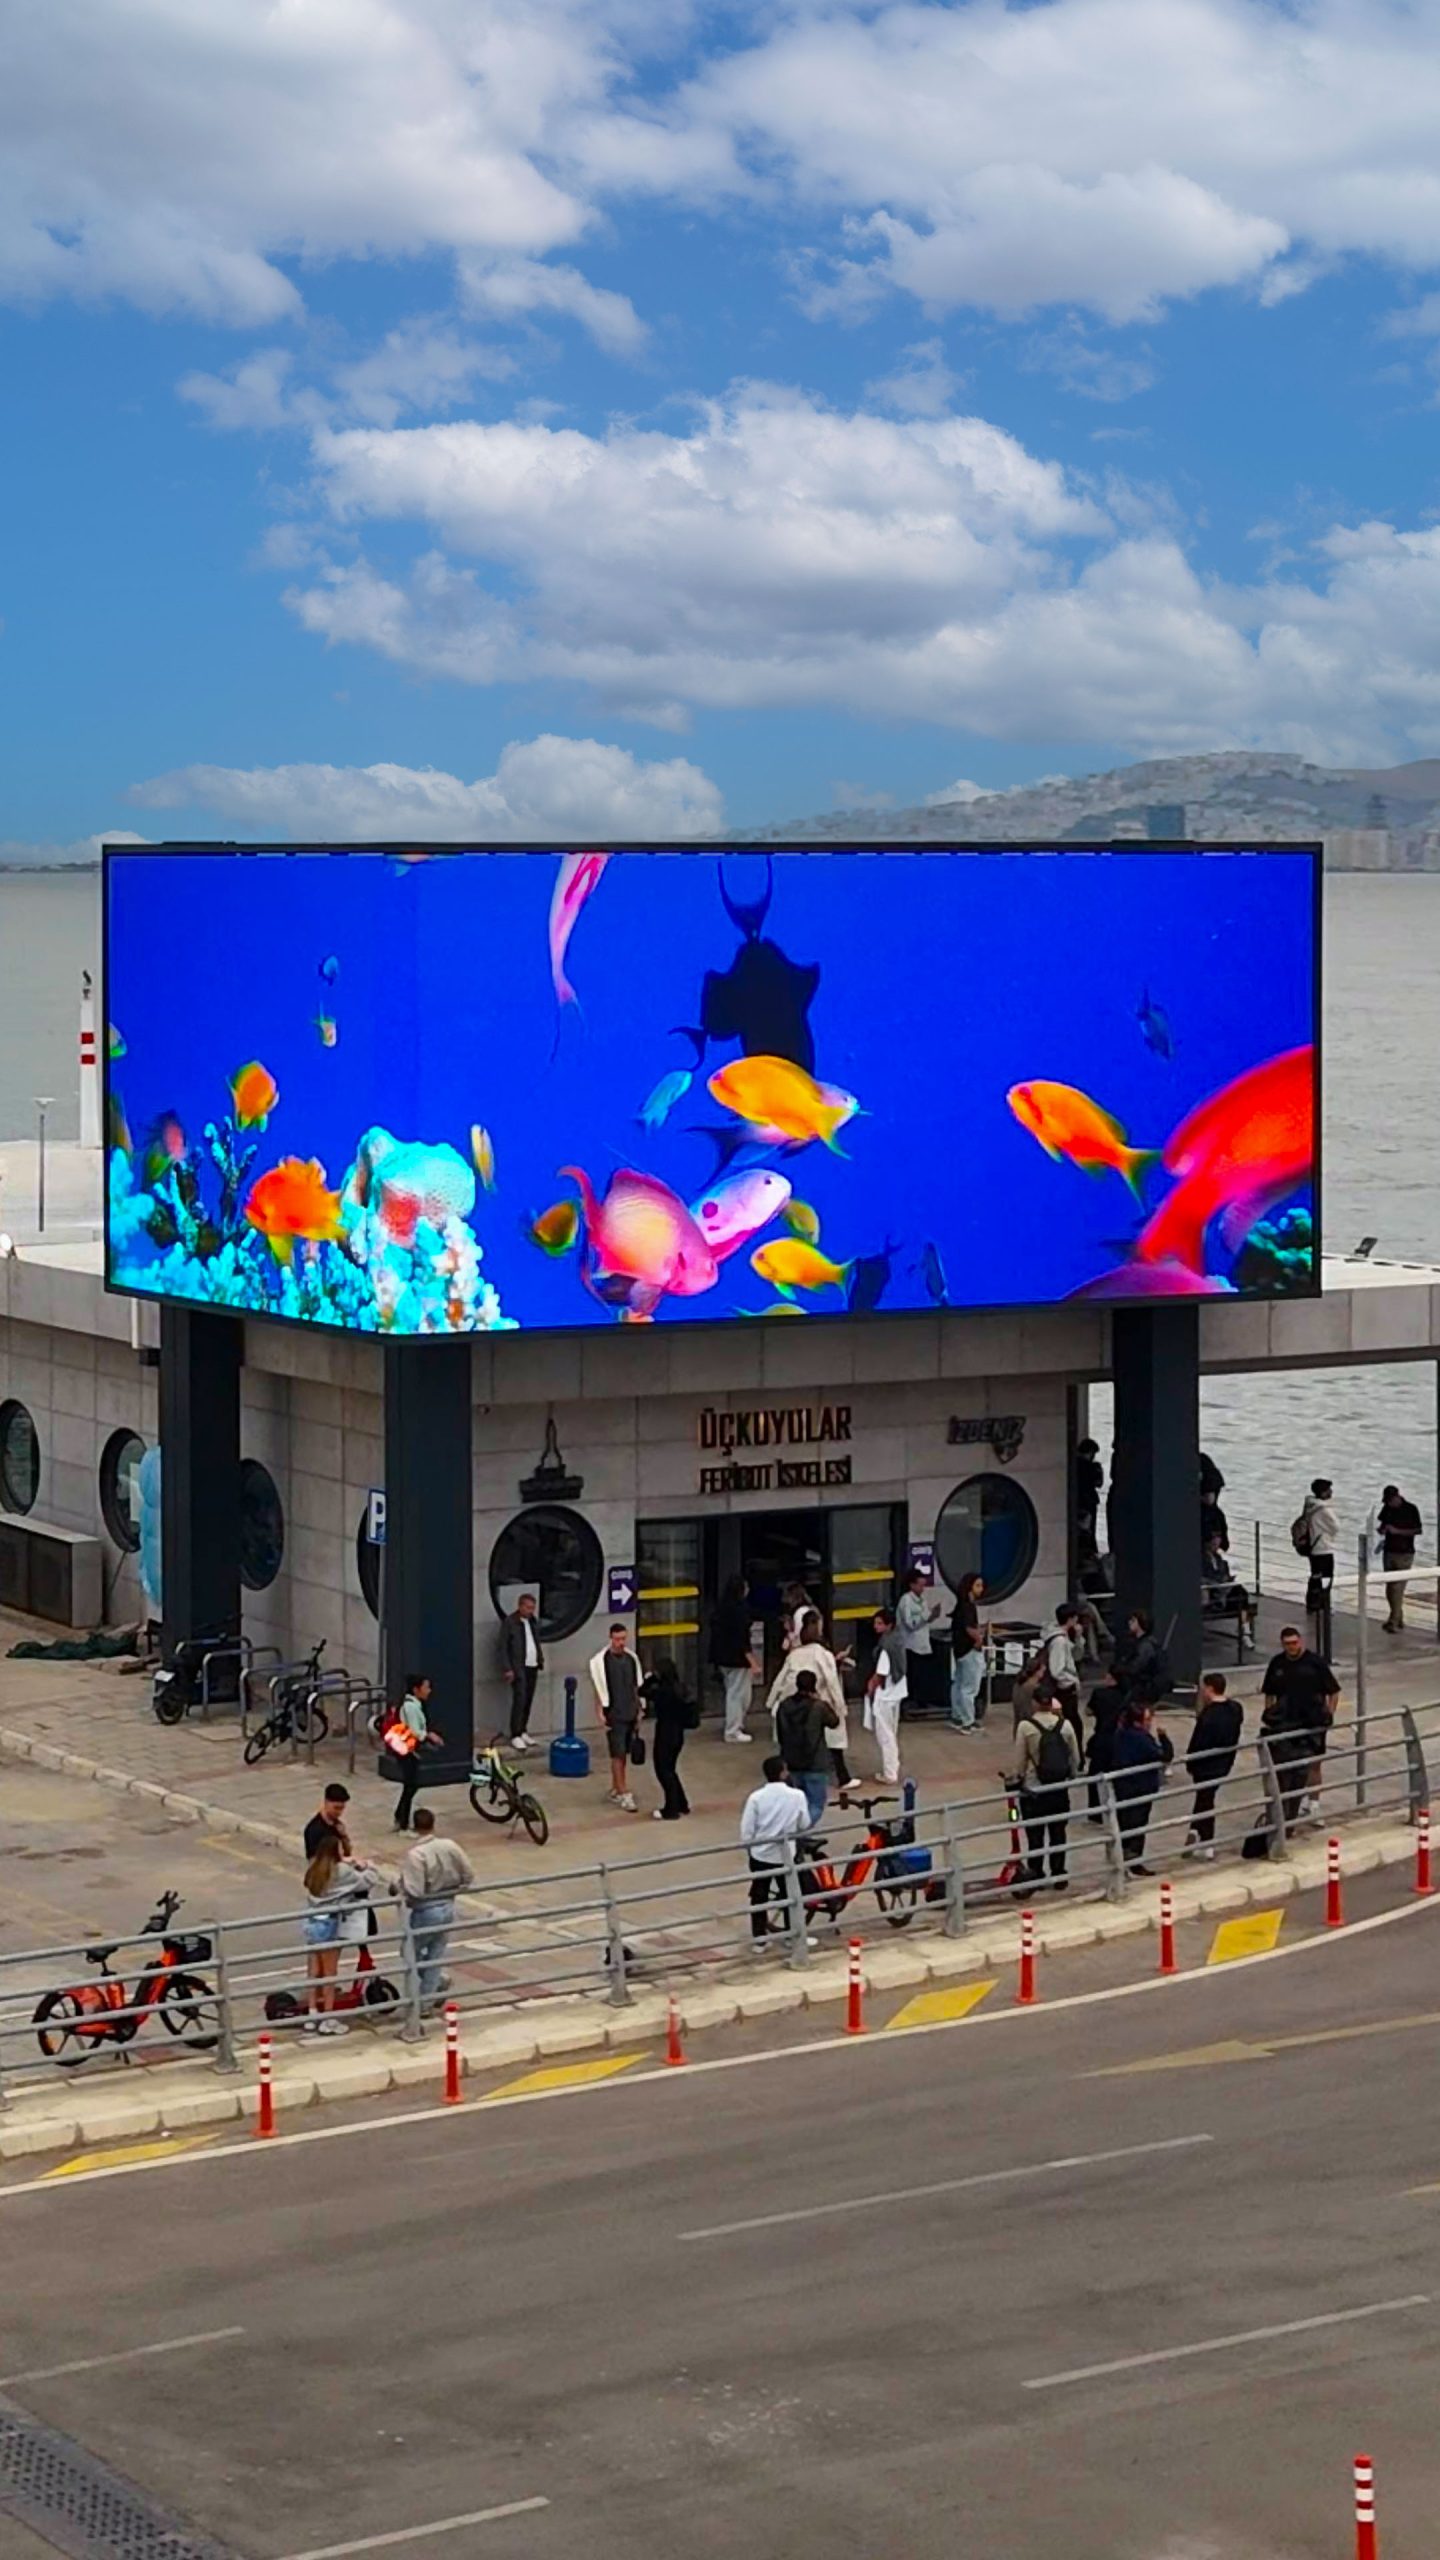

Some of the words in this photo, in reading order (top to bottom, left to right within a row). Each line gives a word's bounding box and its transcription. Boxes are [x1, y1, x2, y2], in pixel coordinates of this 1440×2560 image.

[701, 1407, 852, 1456] ÜÇKUYULAR
[700, 1462, 774, 1494] FERİBOT
[776, 1455, 852, 1488] İSKELESİ
[370, 1492, 386, 1538] P
